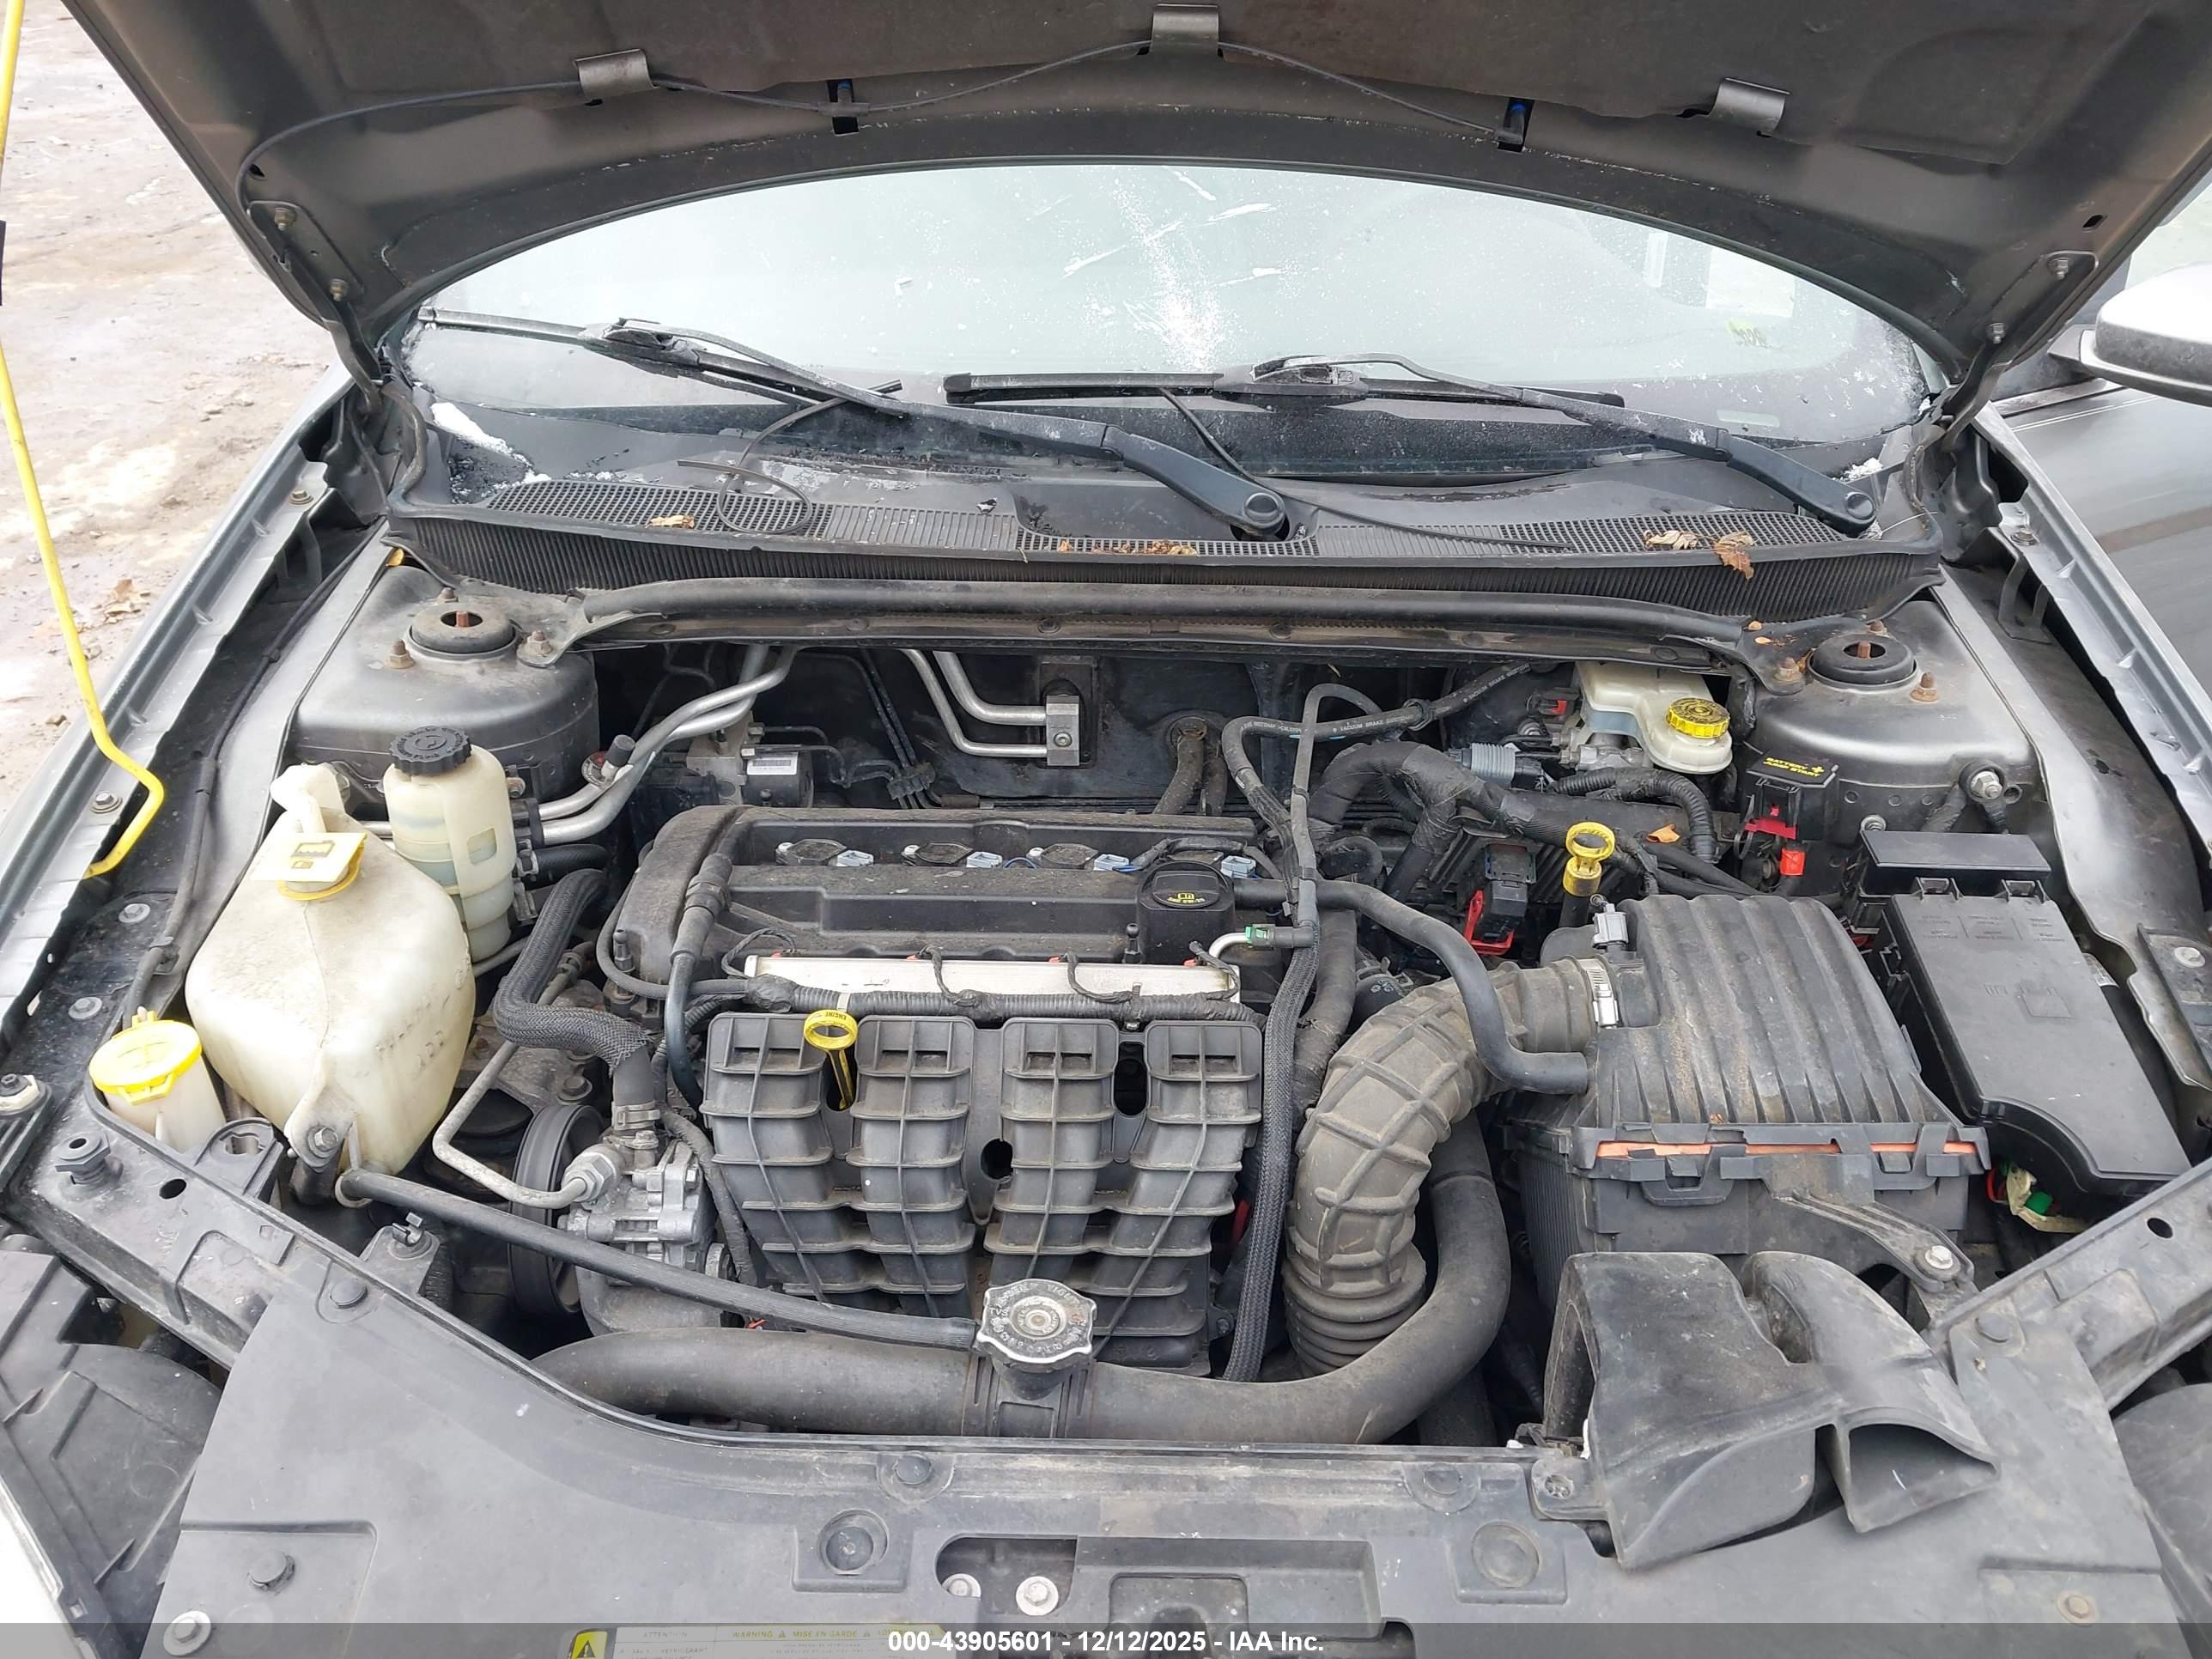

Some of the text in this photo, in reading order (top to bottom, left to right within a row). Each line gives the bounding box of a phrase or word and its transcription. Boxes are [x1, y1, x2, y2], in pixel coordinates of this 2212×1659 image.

[1339, 720, 1382, 732] VACUUM BRAKE
[1762, 761, 1821, 777] JUMP START
[1765, 757, 1808, 770] BATTERY
[824, 1011, 848, 1021] ENGINE
[732, 1630, 772, 1638] WARNING
[792, 1630, 813, 1638] MISE
[829, 1629, 858, 1638] GARDE
